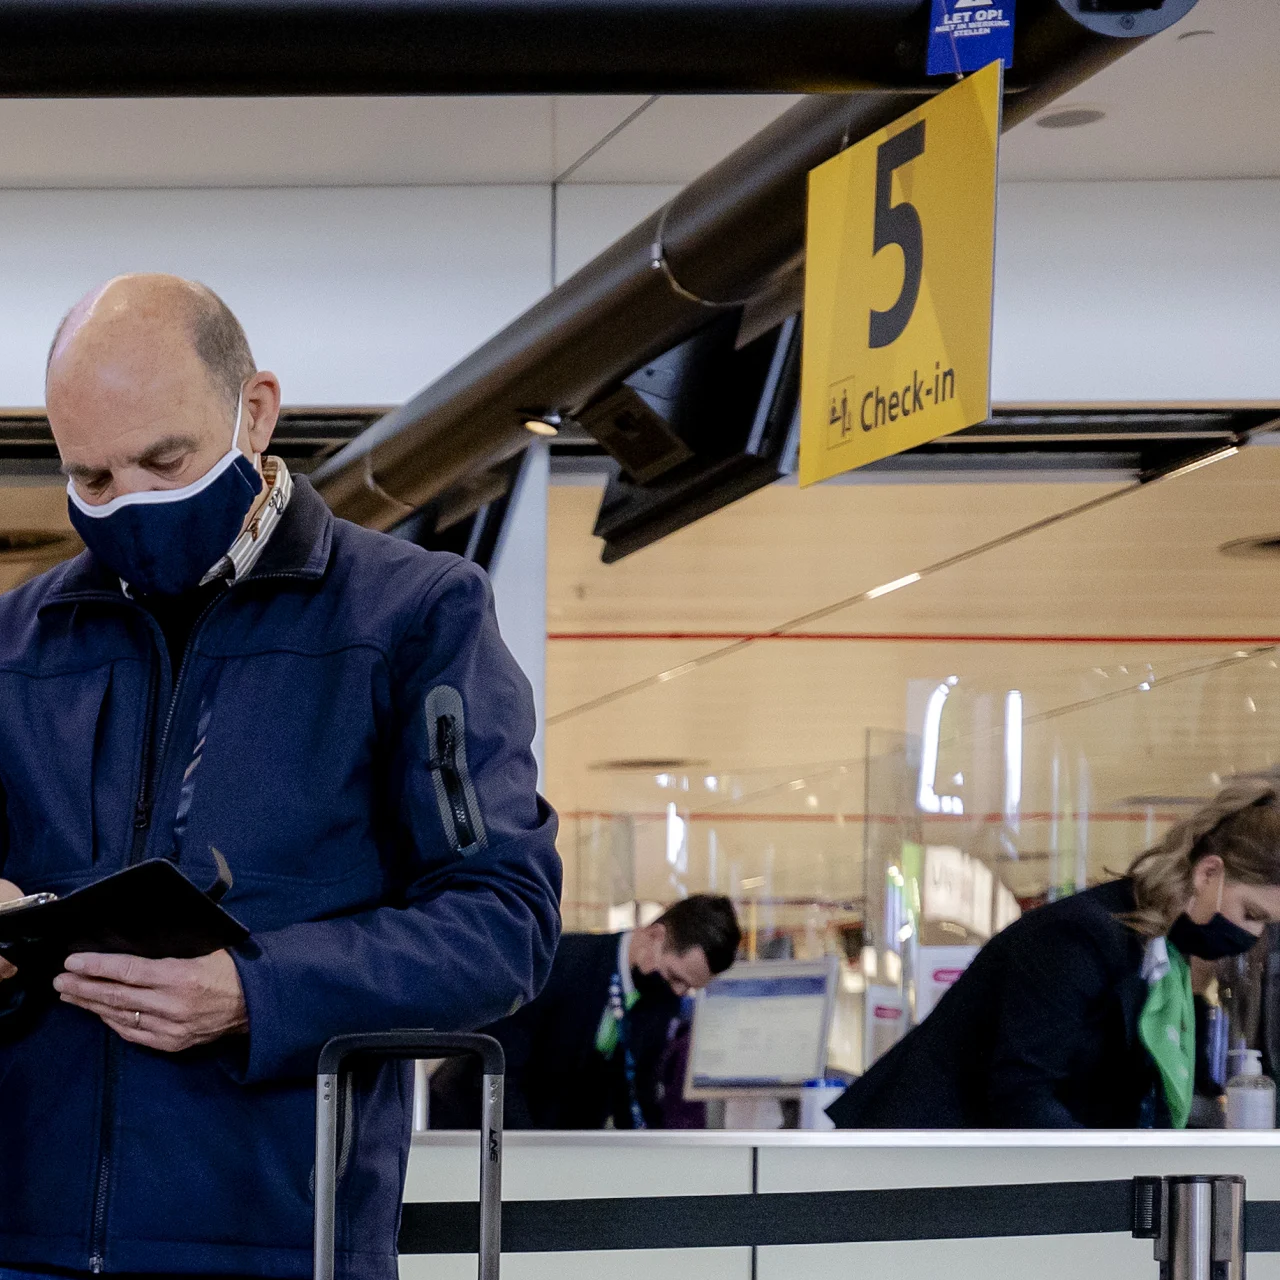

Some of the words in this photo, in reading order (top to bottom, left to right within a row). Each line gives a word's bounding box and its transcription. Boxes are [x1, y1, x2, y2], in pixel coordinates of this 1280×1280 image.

[943, 12, 972, 25] LET
[975, 9, 1003, 21] OP!
[953, 28, 991, 37] STELLEN
[868, 118, 927, 350] 5
[860, 360, 956, 433] Check-in
